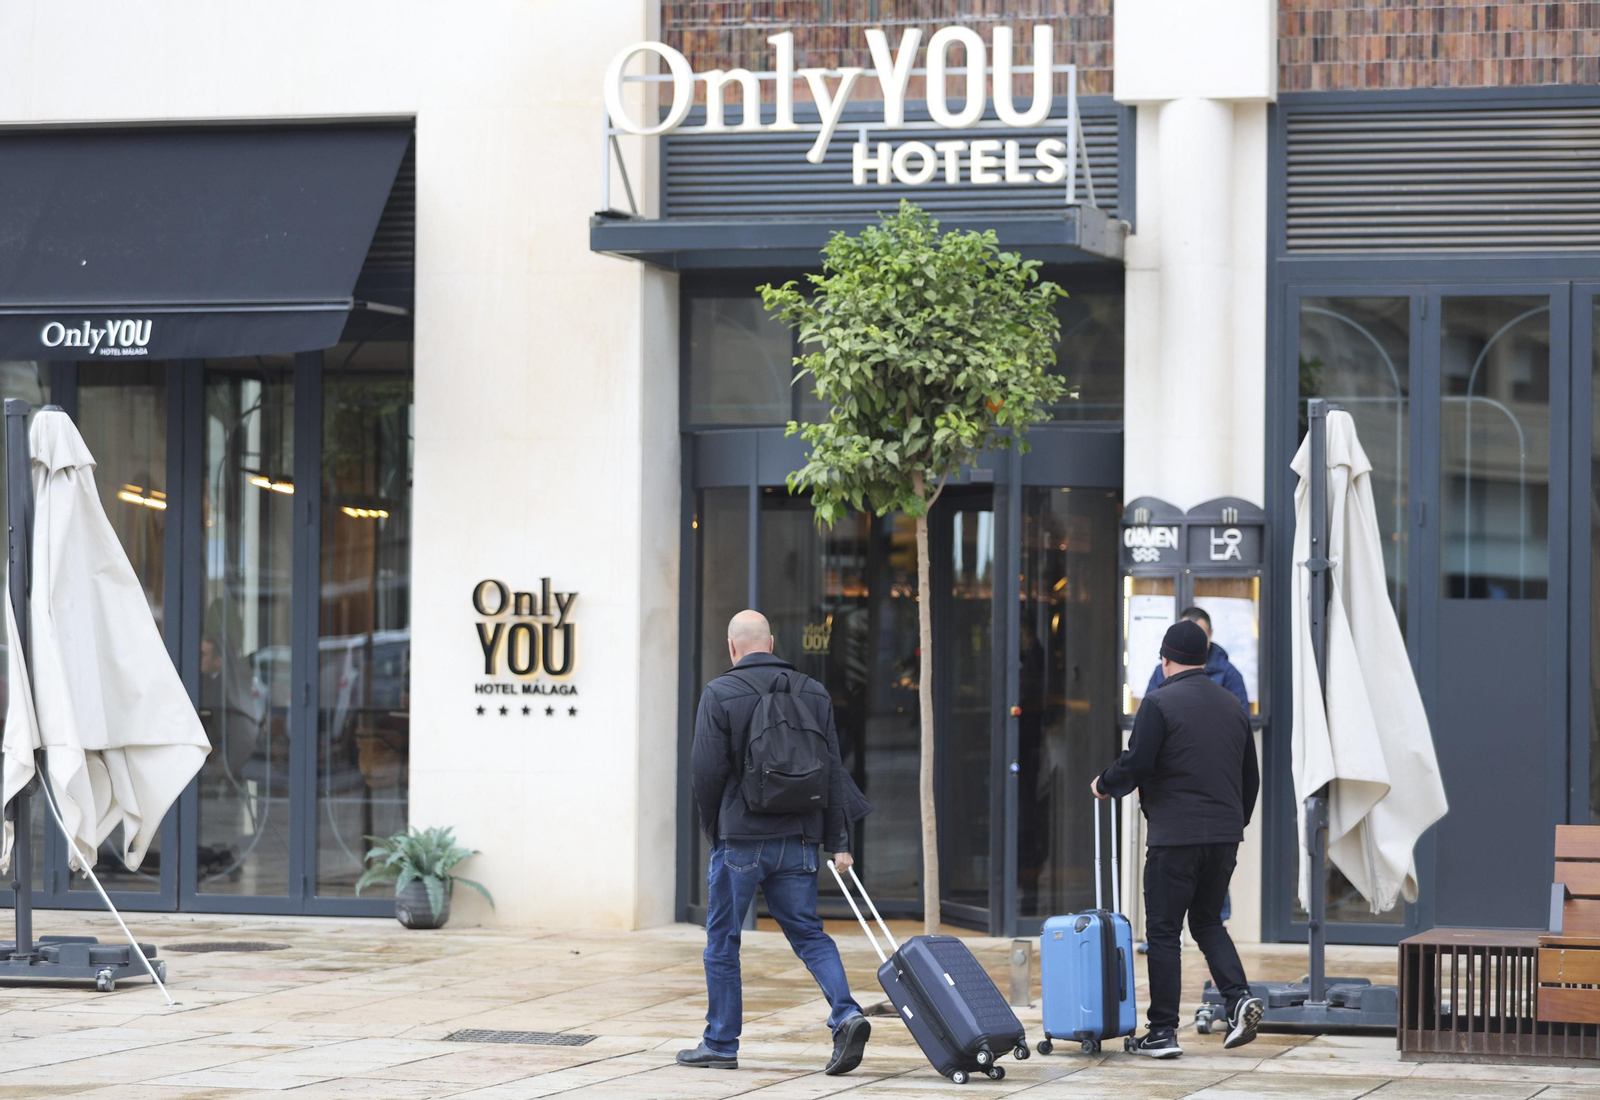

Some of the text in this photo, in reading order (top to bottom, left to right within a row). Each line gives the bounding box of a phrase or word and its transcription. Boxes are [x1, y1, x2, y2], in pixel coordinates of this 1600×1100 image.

[852, 138, 1068, 186] HOTELS
[100, 347, 121, 356] HOTEL
[472, 577, 579, 629] Only
[475, 622, 576, 676] YOU
[475, 680, 579, 696] HOTEL MÁLAGA
